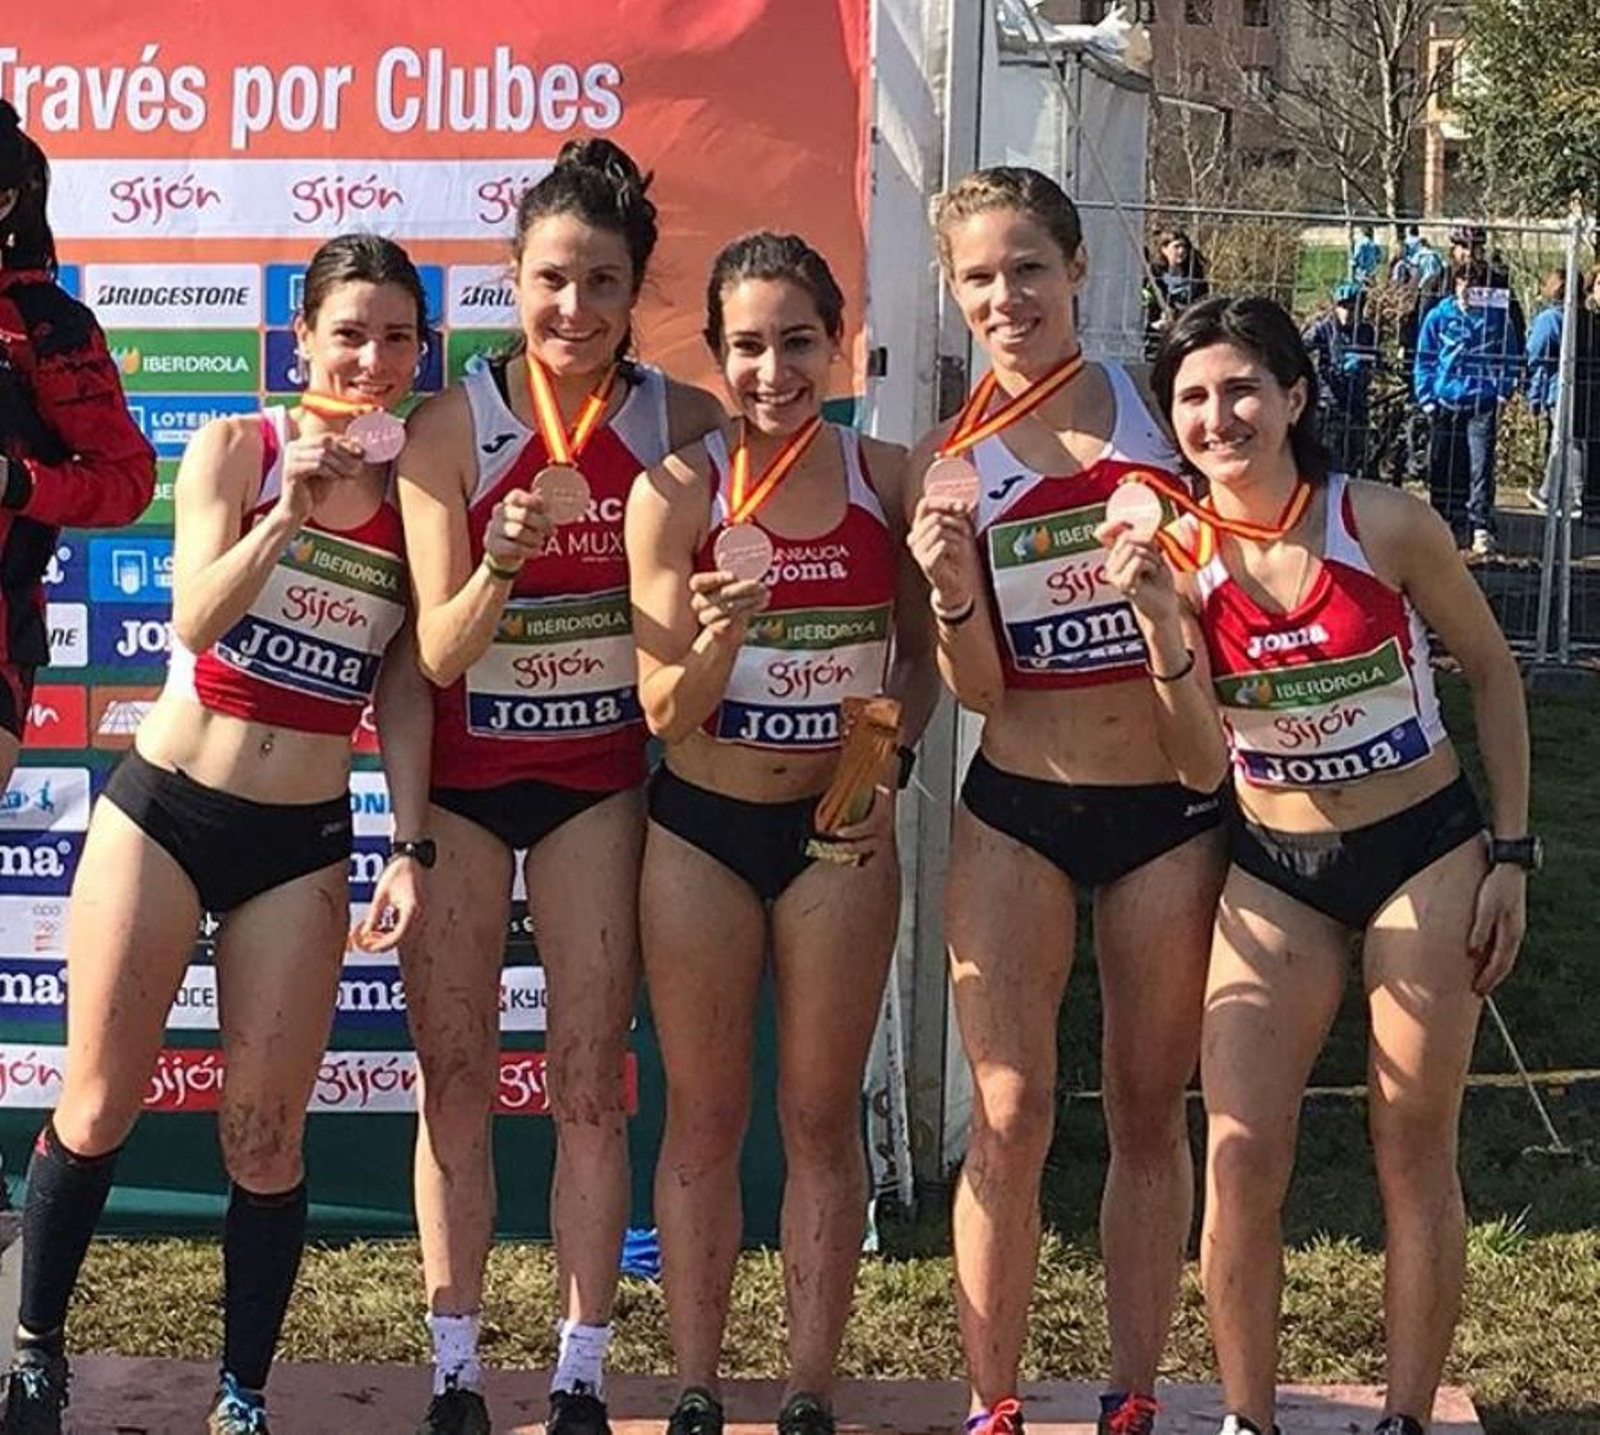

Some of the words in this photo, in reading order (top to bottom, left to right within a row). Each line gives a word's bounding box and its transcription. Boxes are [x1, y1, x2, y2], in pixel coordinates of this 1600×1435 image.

[0, 44, 207, 132] Través
[231, 62, 354, 149] por
[376, 46, 622, 131] Clubes
[110, 175, 221, 225] gijón
[292, 175, 404, 225] gijón
[98, 286, 250, 306] BRIDGESTONE
[143, 355, 249, 373] IBERDROLA
[313, 549, 397, 590] IBERDROLA
[1046, 562, 1109, 606] gij
[282, 585, 367, 629] gijón
[527, 611, 628, 636] IBERDROLA
[787, 621, 876, 641] IBERDROLA
[1033, 608, 1138, 657] Jom
[512, 649, 604, 690] gijón
[767, 655, 854, 698] gijón
[1276, 665, 1386, 699] IBERDROLA
[739, 710, 839, 740] Jom
[1274, 704, 1367, 749] gijón
[0, 845, 65, 877] ma
[0, 972, 65, 1005] ma
[0, 1051, 64, 1098] jón
[500, 1060, 550, 1110] gij
